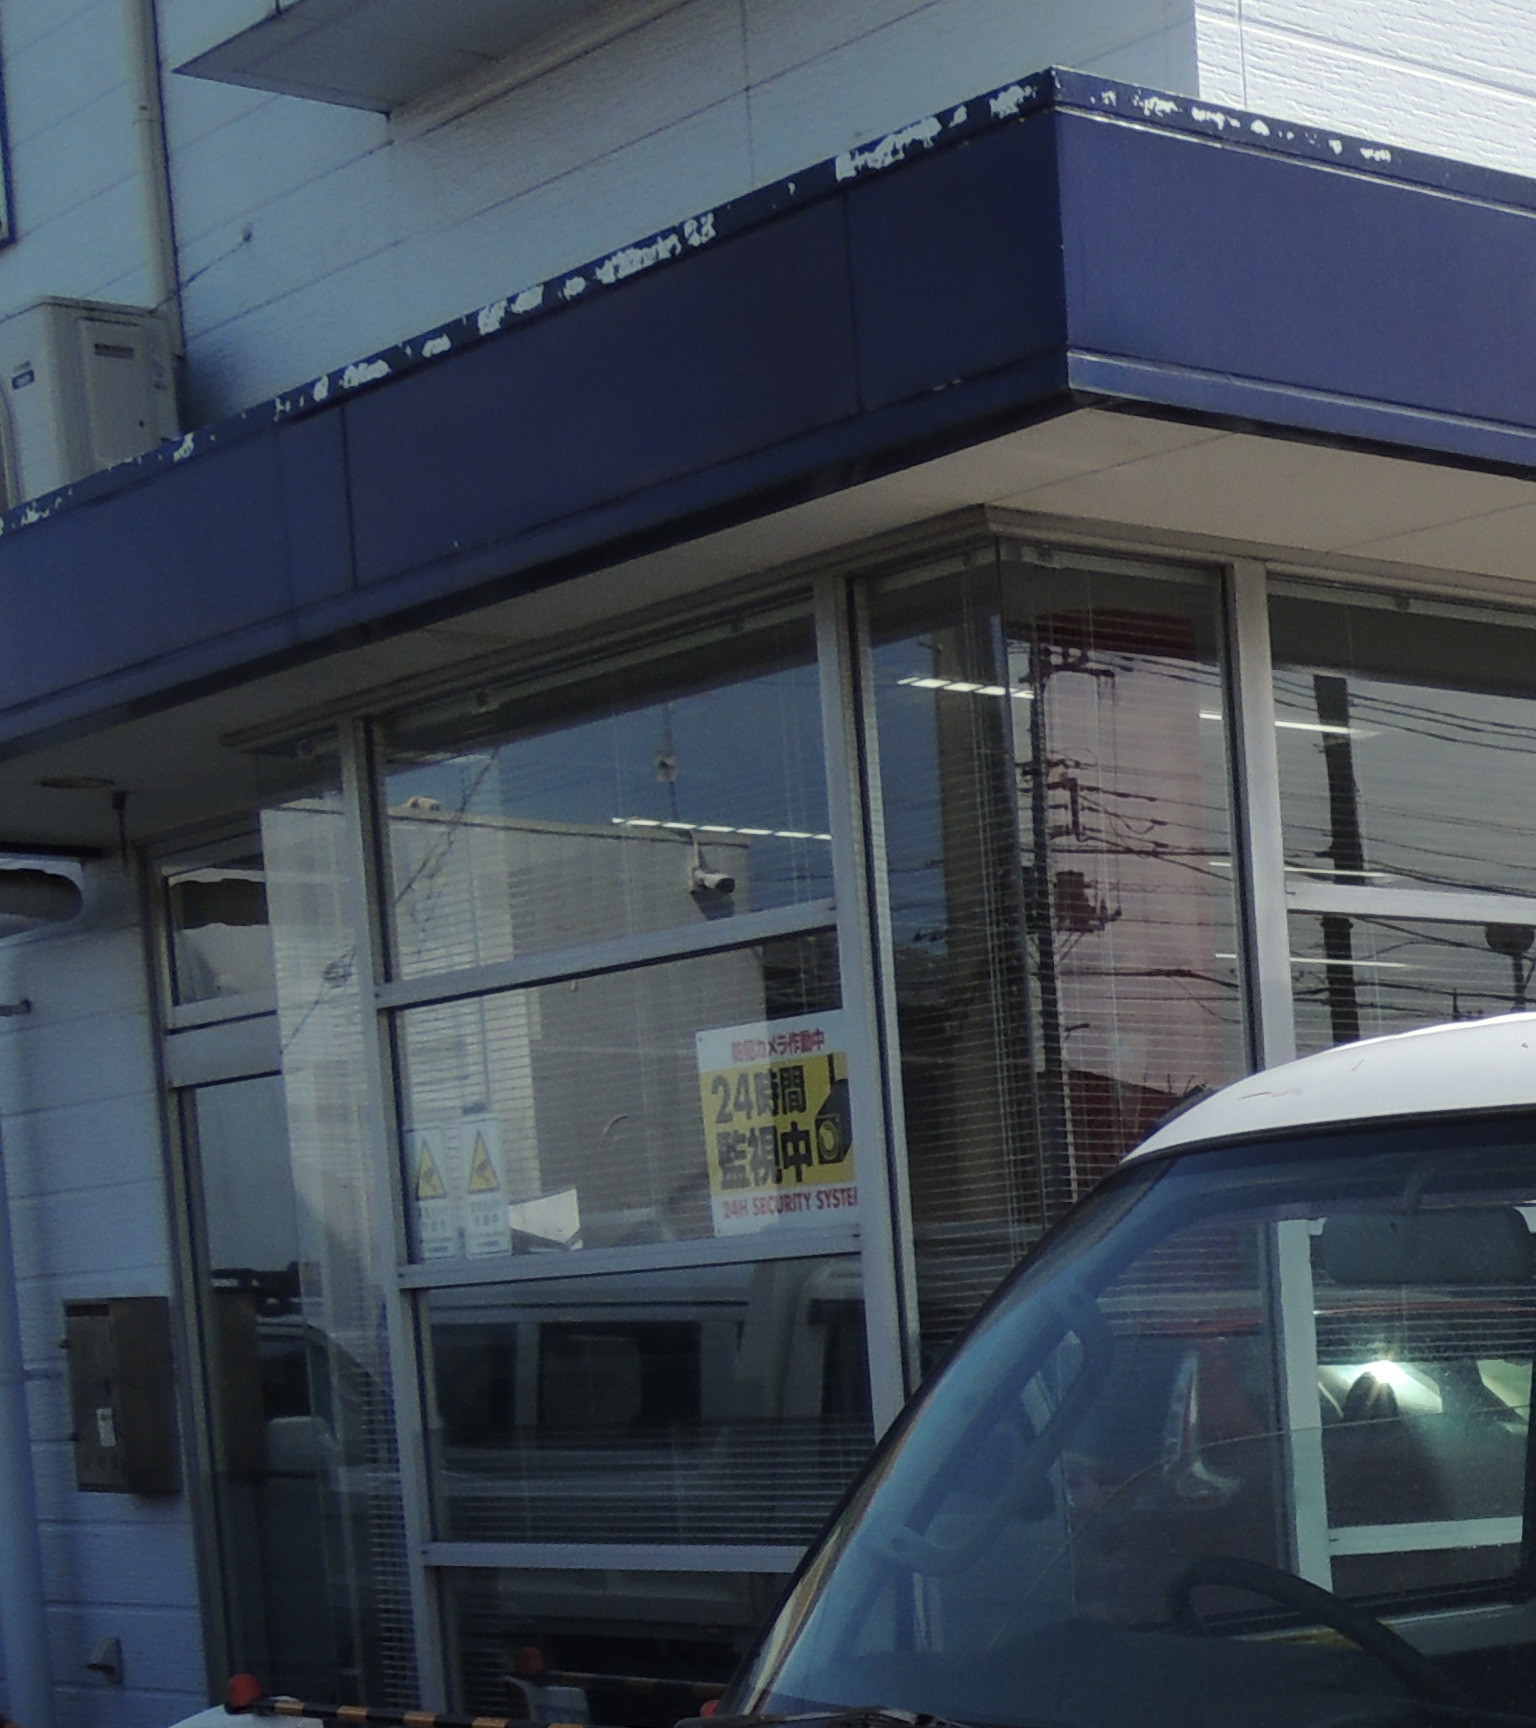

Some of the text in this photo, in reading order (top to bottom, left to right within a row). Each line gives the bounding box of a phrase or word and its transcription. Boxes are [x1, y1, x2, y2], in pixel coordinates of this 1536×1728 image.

[711, 1064, 807, 1124] 24時間
[715, 1121, 813, 1190] 監視中
[723, 1186, 858, 1218] 24H SECURITY SYSTE
